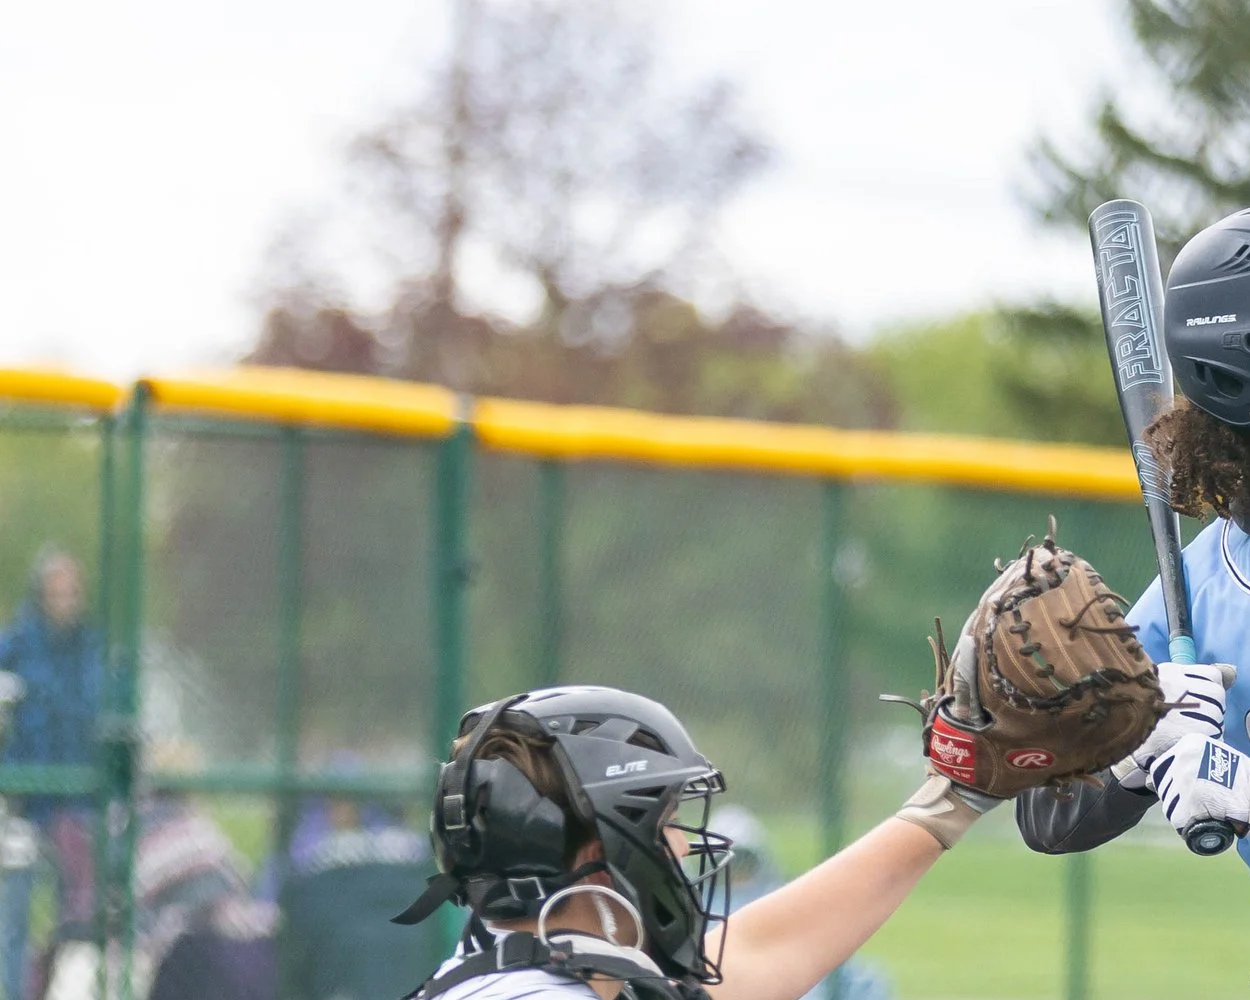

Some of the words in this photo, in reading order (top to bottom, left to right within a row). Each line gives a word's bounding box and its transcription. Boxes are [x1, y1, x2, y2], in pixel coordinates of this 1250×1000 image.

[1186, 313, 1237, 327] RAWLINGS
[931, 734, 971, 764] Rawlings
[605, 760, 649, 777] ELITE
